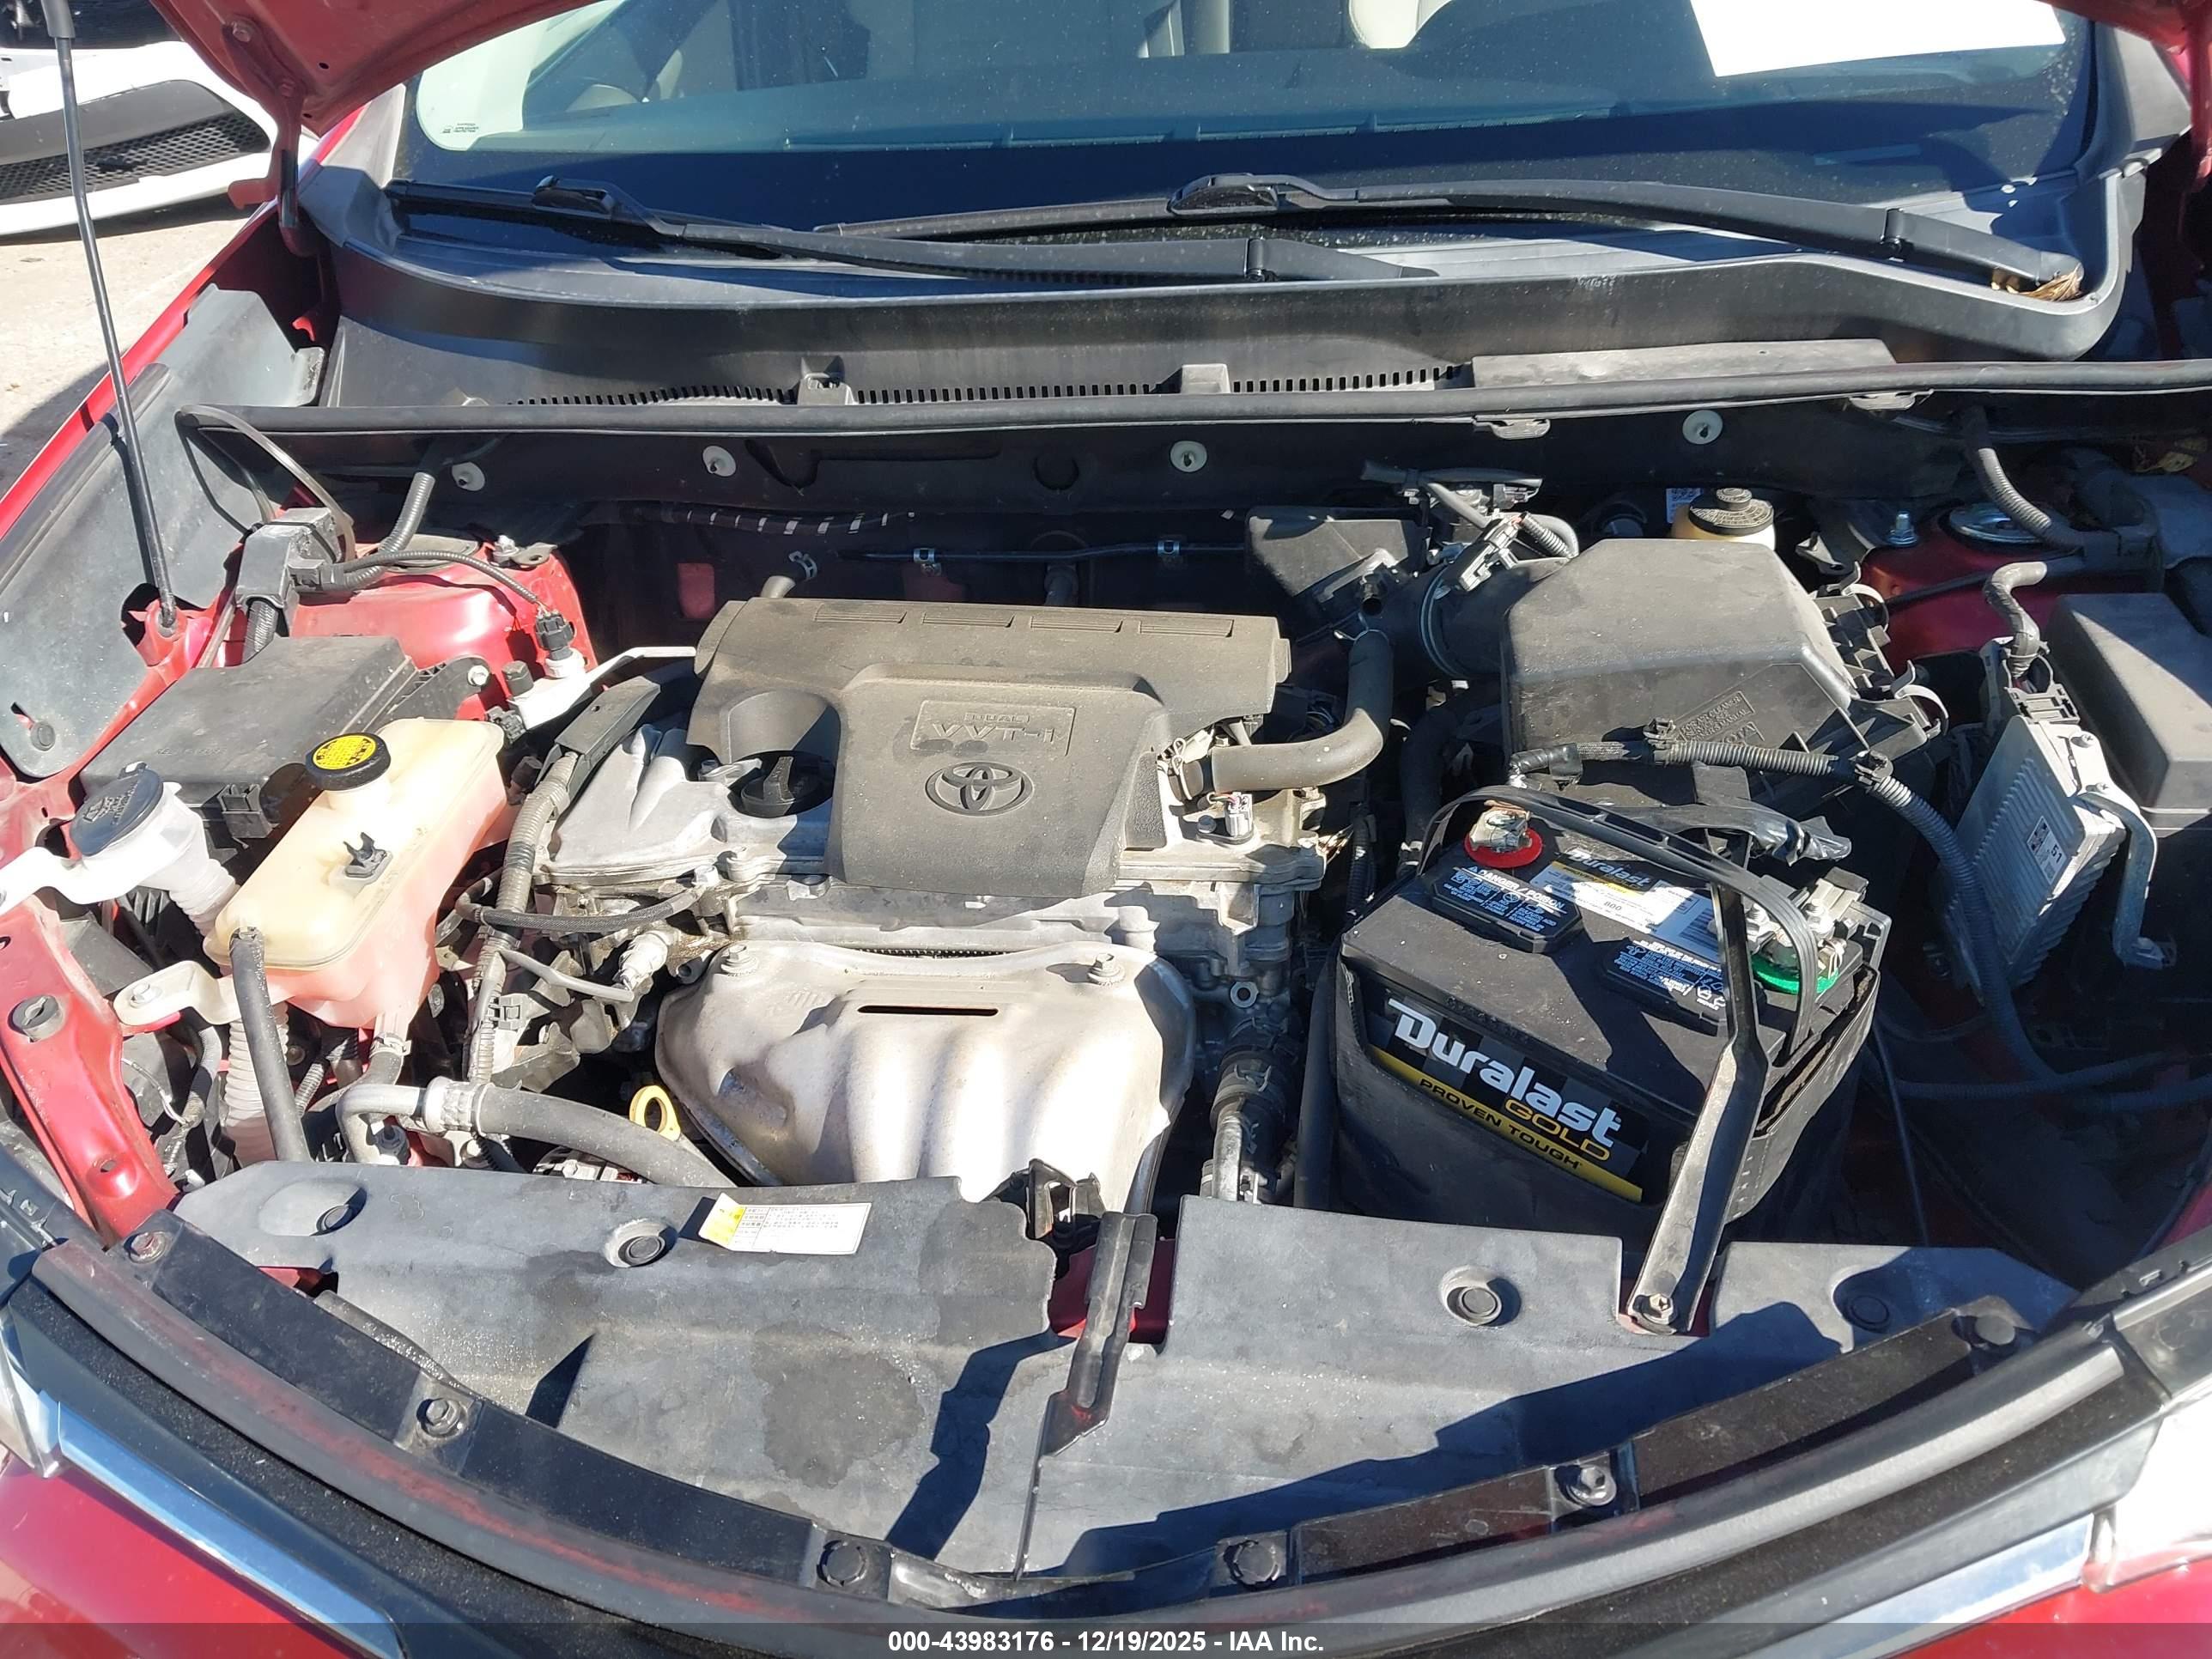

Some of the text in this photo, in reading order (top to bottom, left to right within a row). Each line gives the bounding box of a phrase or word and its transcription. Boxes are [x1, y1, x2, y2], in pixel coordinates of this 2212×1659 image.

[1478, 870, 1520, 890] DANGER
[1527, 888, 1565, 909] POISON
[1567, 848, 1654, 887] Duralast
[1388, 998, 1622, 1148] Duralast
[1419, 1078, 1580, 1170] PROVEN TOUGH
[1504, 1097, 1610, 1161] GOLD
